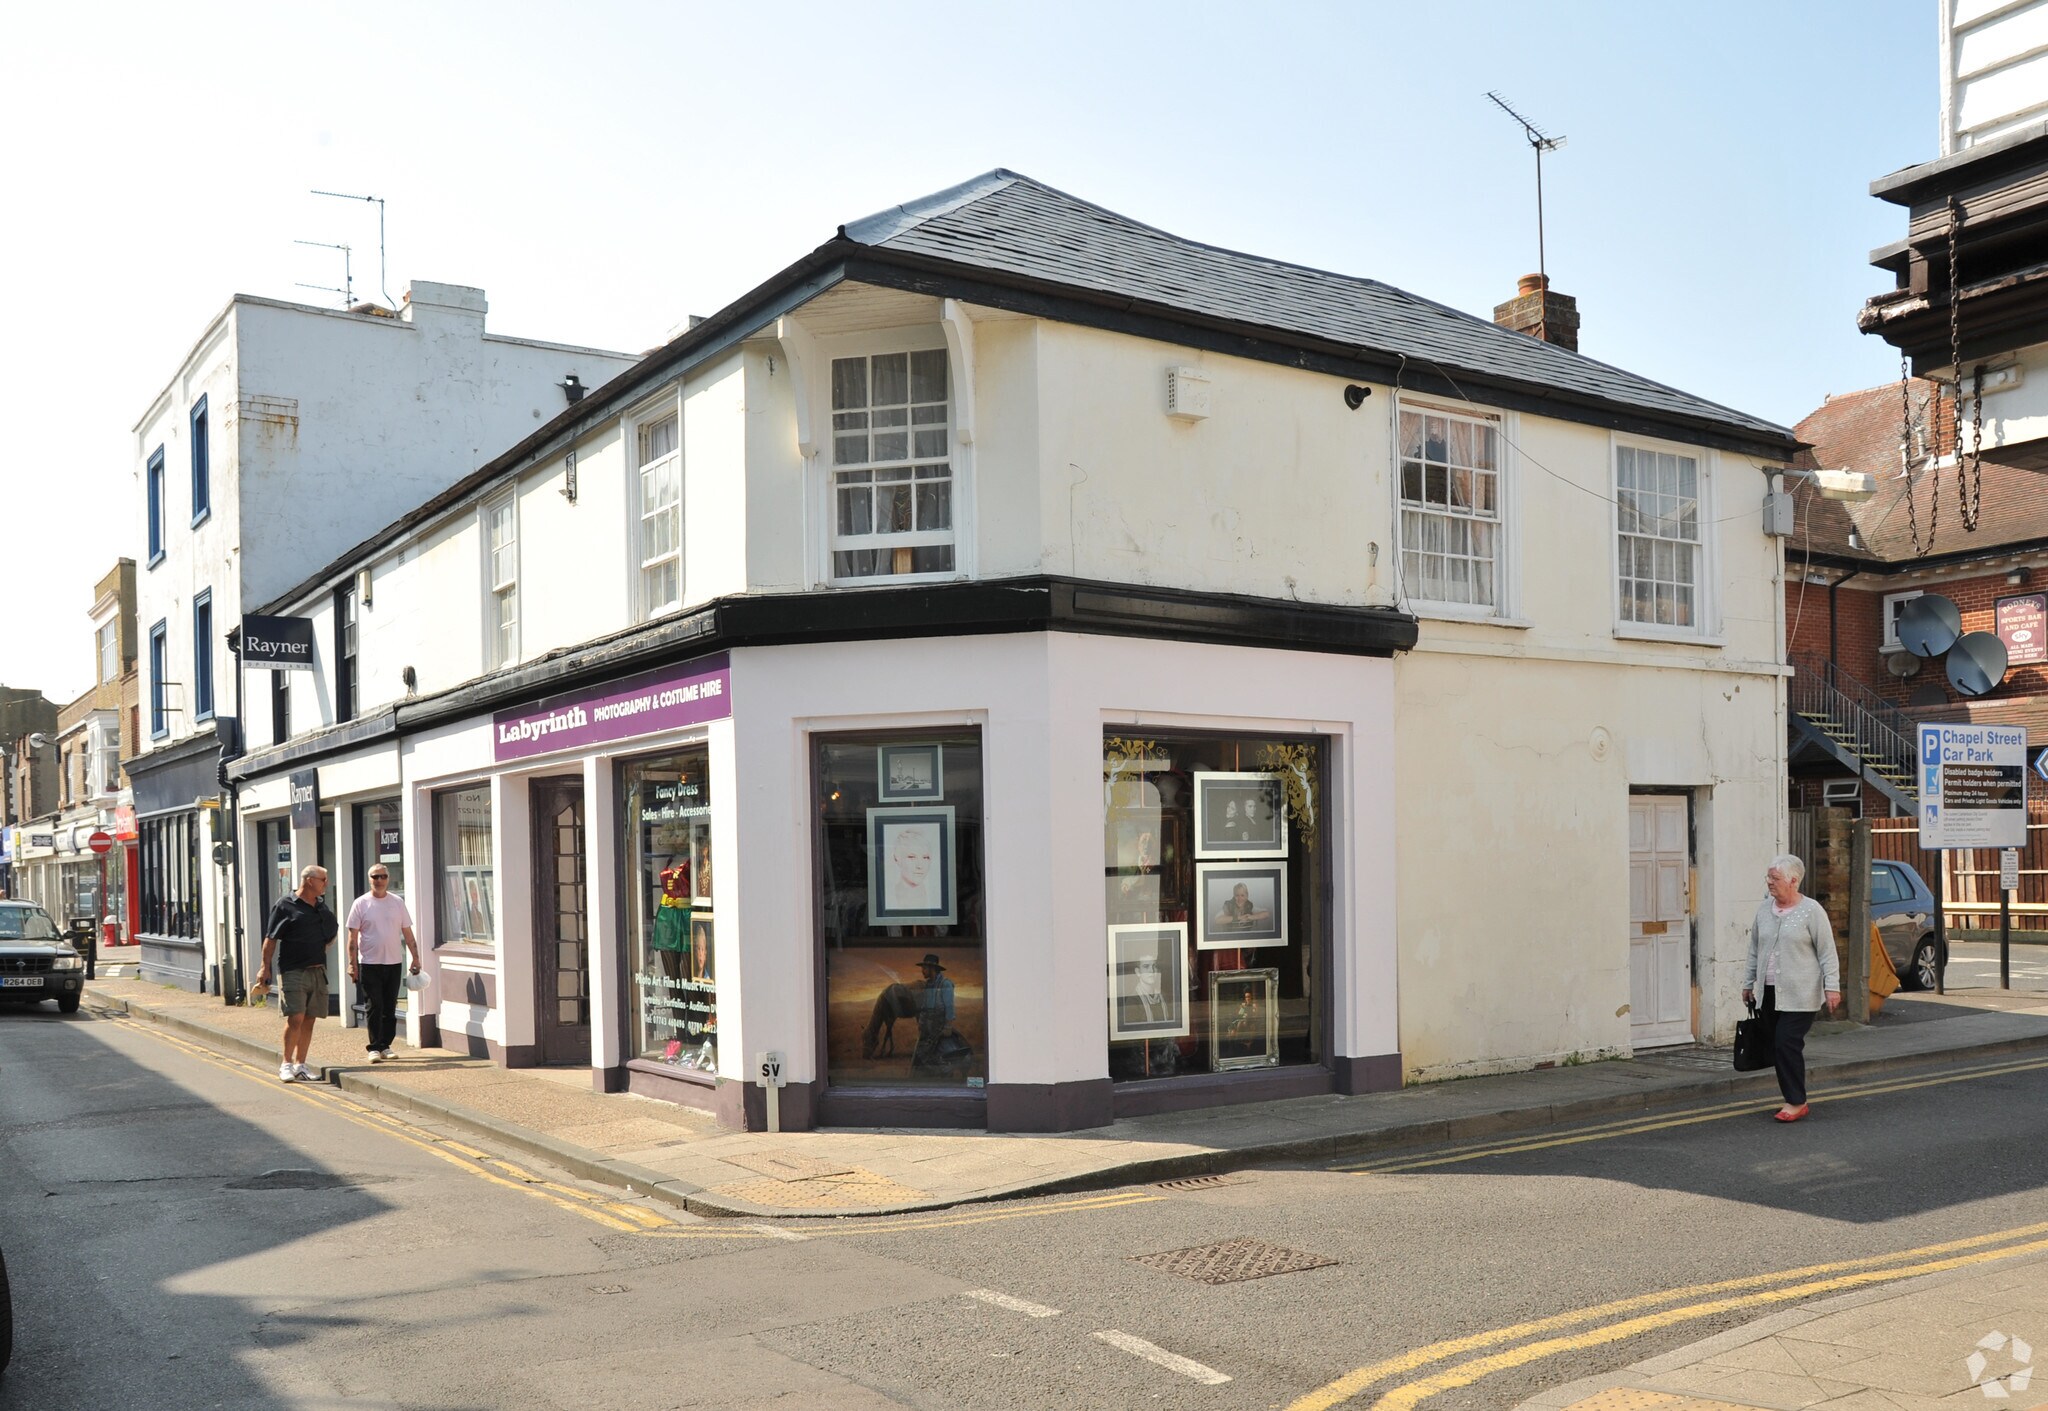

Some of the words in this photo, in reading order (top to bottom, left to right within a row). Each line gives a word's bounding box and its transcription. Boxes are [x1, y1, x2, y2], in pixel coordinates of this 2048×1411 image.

[2001, 599, 2042, 614] RODNEYS
[2001, 616, 2026, 624] SPORTS
[246, 636, 309, 657] Rayner
[247, 662, 309, 670] OPTICIANS
[499, 706, 587, 743] Labyrinth
[594, 695, 651, 722] PHOTOGRAPHY
[652, 694, 659, 709] &
[660, 685, 698, 708] COSTUME
[700, 679, 722, 699] HIRE
[1943, 730, 1983, 747] Chapel
[1987, 731, 2022, 745] Street
[1943, 747, 1963, 761] Car
[1967, 748, 1994, 762] Park
[1944, 767, 1966, 776] Disabled
[1968, 768, 1983, 778] badge
[1984, 769, 2003, 777] holders
[1944, 778, 1962, 786] Permit
[1962, 779, 1982, 787] holders
[1997, 780, 2022, 788] permitted
[291, 782, 313, 811] Rayner
[656, 785, 676, 802] Fancy
[678, 783, 698, 797] Dress
[642, 808, 657, 821] Sales
[661, 806, 674, 819] Hire
[679, 802, 712, 818] Accessorie
[663, 975, 675, 988] Film
[676, 978, 681, 989] &
[681, 978, 698, 991] Music
[663, 998, 686, 1009] Portfolios
[689, 1001, 710, 1013] Audition
[762, 1063, 780, 1077] SV
